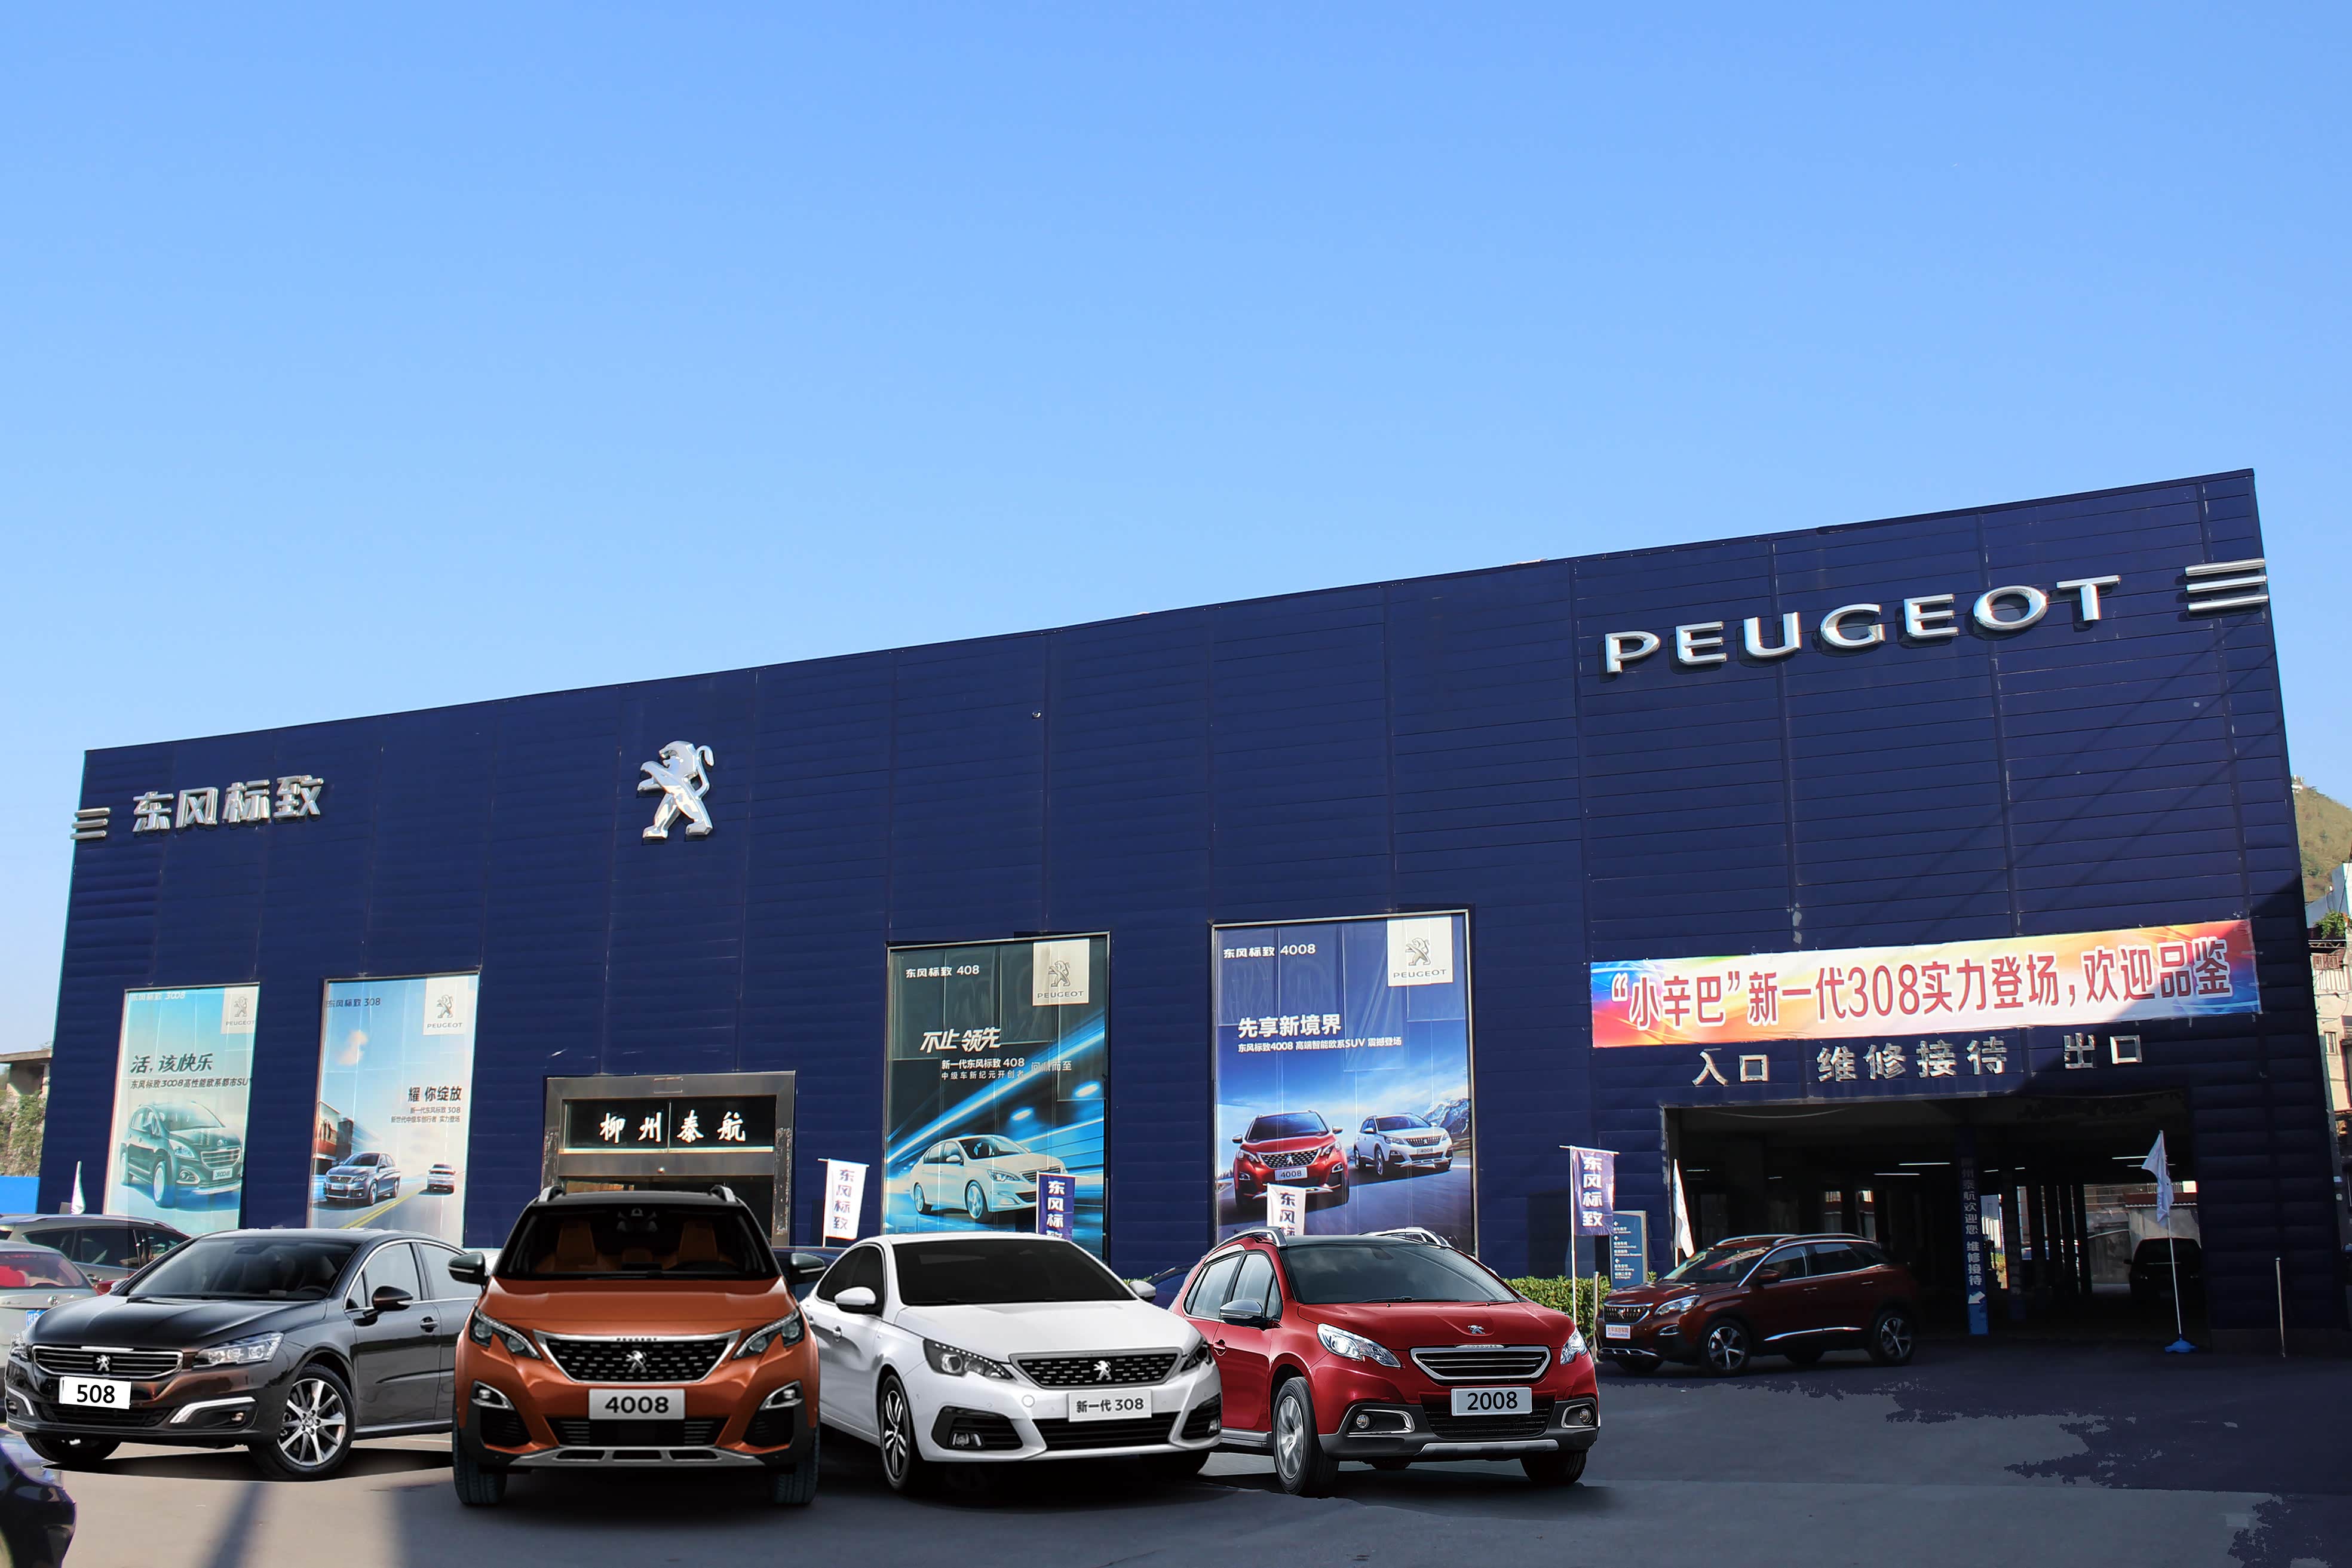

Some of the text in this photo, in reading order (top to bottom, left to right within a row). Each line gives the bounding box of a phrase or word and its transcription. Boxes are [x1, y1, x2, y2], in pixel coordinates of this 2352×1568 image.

[1605, 574, 2122, 674] PEUGEOT
[133, 775, 323, 833] 东风标致
[1223, 944, 1316, 959] 东风标致 4008
[906, 965, 980, 978] 东风标致 408
[1393, 969, 1447, 978] PEUGEOT
[164, 992, 186, 1000] 3008
[364, 998, 381, 1007] 308
[1037, 990, 1084, 999] PEUGEOT
[1238, 1013, 1342, 1039] 先享新境界
[1238, 1041, 1293, 1053] 东风标致4008
[1296, 1038, 1365, 1050] 高端智能欧系SUV
[942, 1058, 1001, 1070] 新一代东风标致
[1003, 1057, 1025, 1067] 408
[1692, 1032, 2142, 1086] 入口 维修接待 出口
[425, 1086, 462, 1102] 你绽放
[599, 1109, 746, 1144] 柳州泰航
[1280, 1170, 1302, 1179] 4008
[833, 1168, 855, 1231] 东风标致
[1582, 1156, 1603, 1227] 东风标致
[1966, 1241, 1983, 1286] 维修接待
[76, 1384, 115, 1404] 508
[1467, 1391, 1518, 1410] 2008
[605, 1396, 669, 1414] 4008
[1076, 1398, 1144, 1413] 新一代 308
